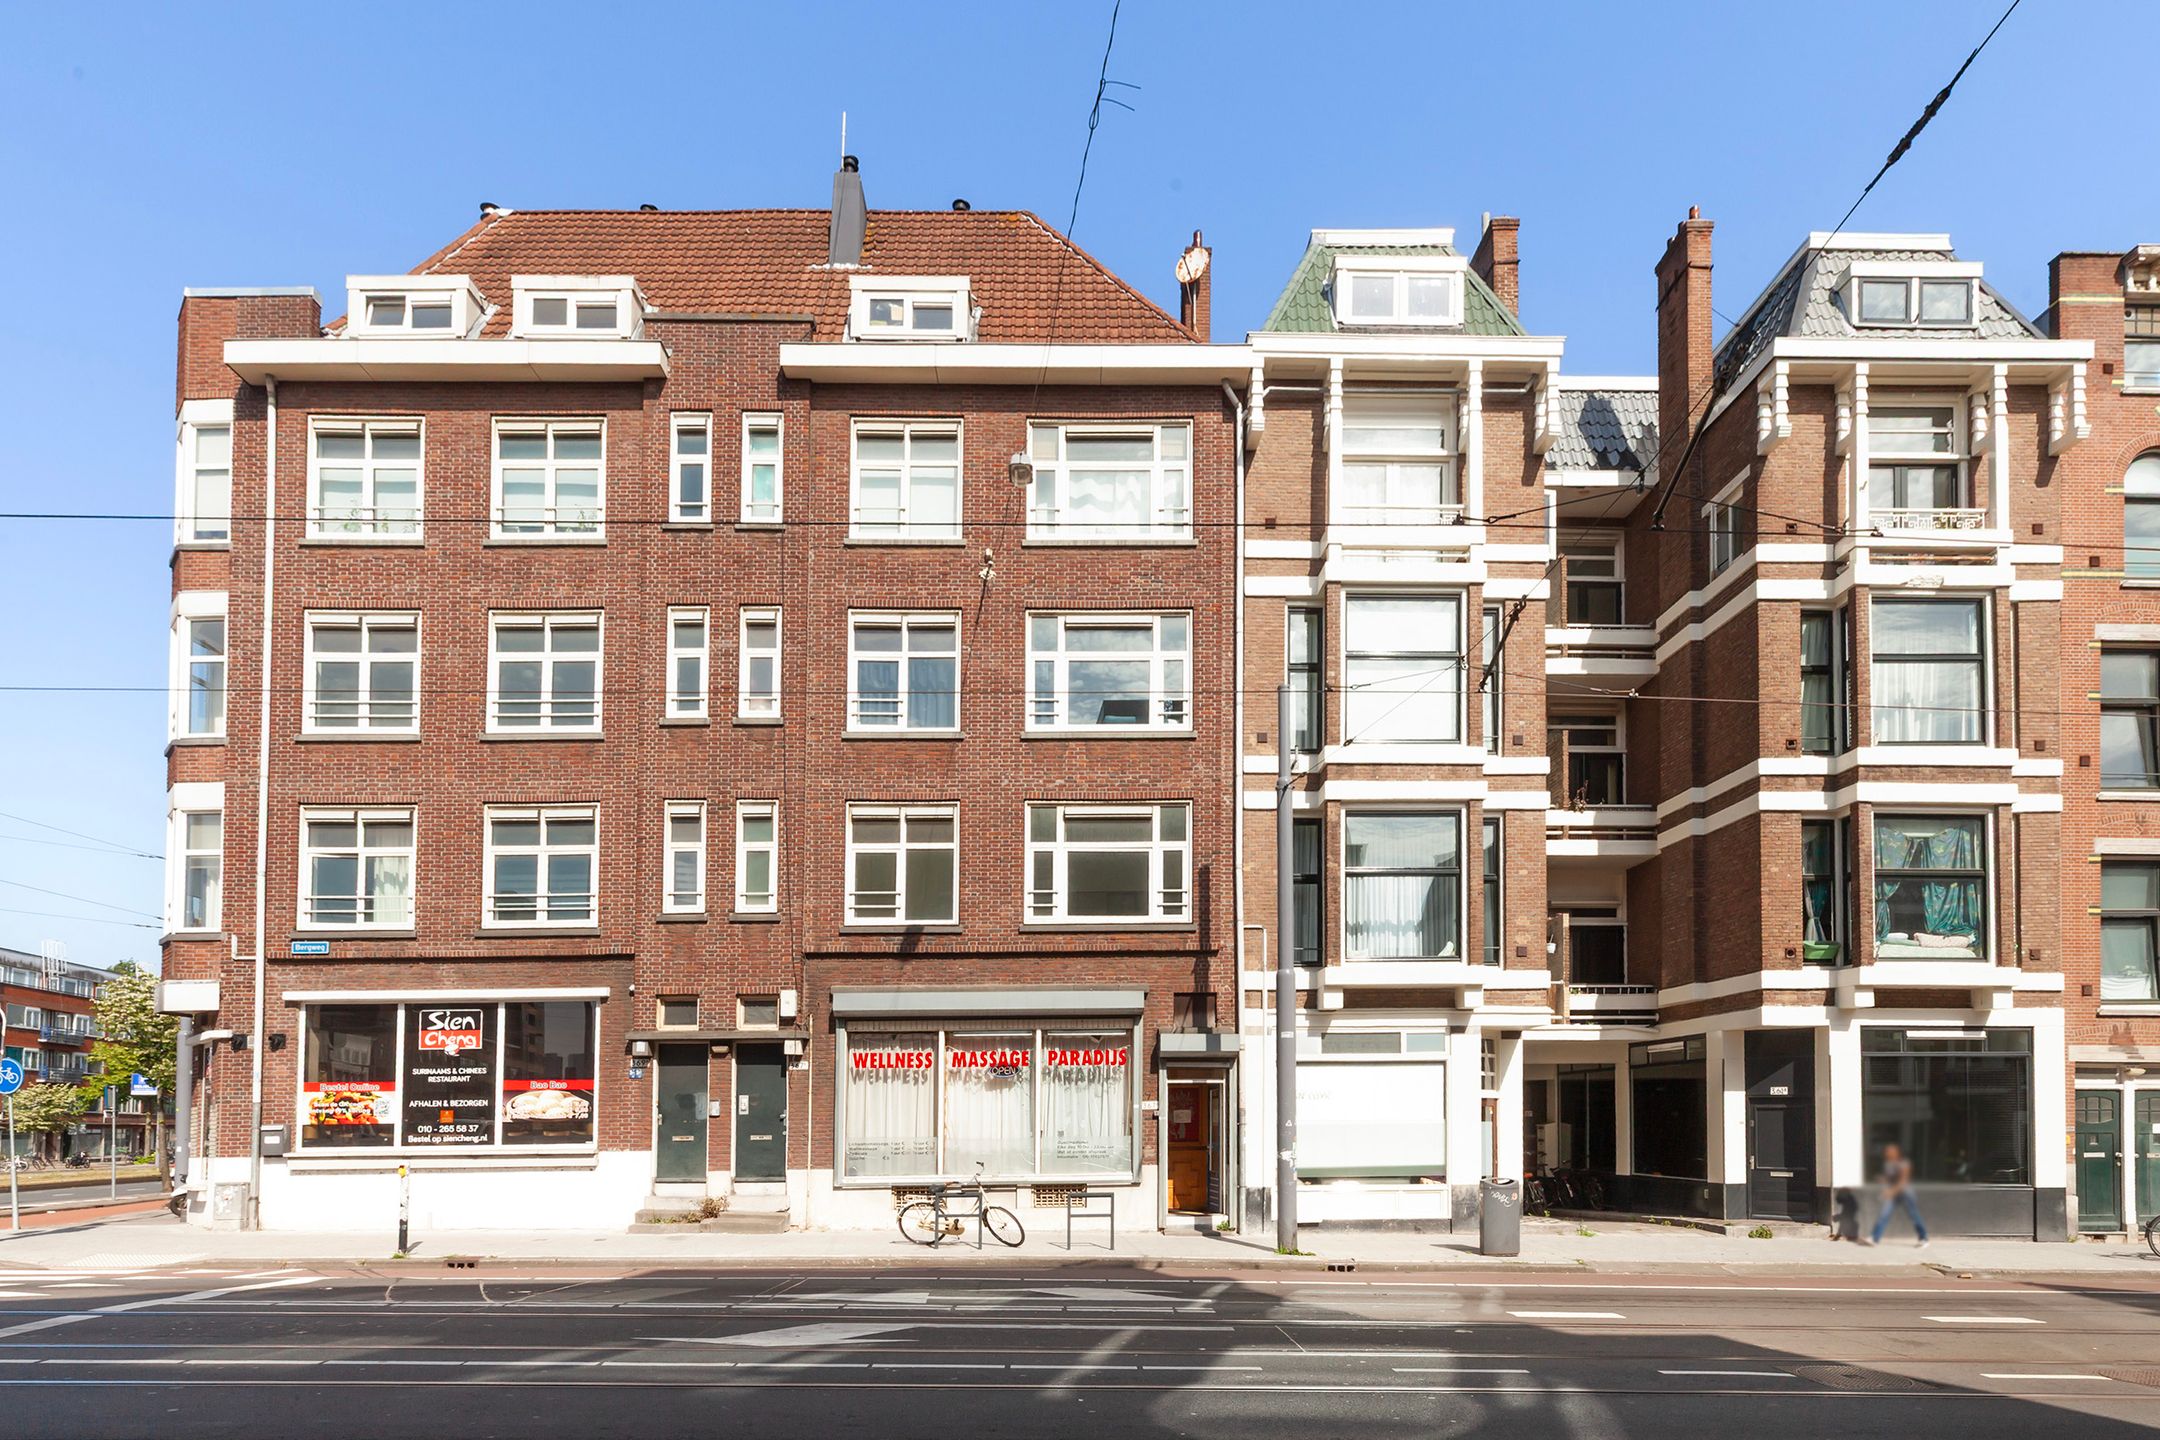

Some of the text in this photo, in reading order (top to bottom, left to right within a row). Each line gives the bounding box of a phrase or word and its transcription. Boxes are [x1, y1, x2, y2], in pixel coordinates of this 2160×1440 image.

[295, 943, 325, 952] Bergweg
[427, 1011, 476, 1030] Sien
[424, 1031, 477, 1048] Cheng
[853, 1048, 1127, 1069] WELLNESS MASSAGE PARADIJS
[991, 1066, 1016, 1075] OPEN
[320, 1083, 380, 1091] Bestel Online
[530, 1080, 568, 1089] Bao Bao
[450, 1099, 488, 1107] BEZORGEN
[417, 1125, 432, 1133] 010
[439, 1125, 455, 1133] 265
[408, 1135, 431, 1143] Bestel
[432, 1136, 442, 1144] op
